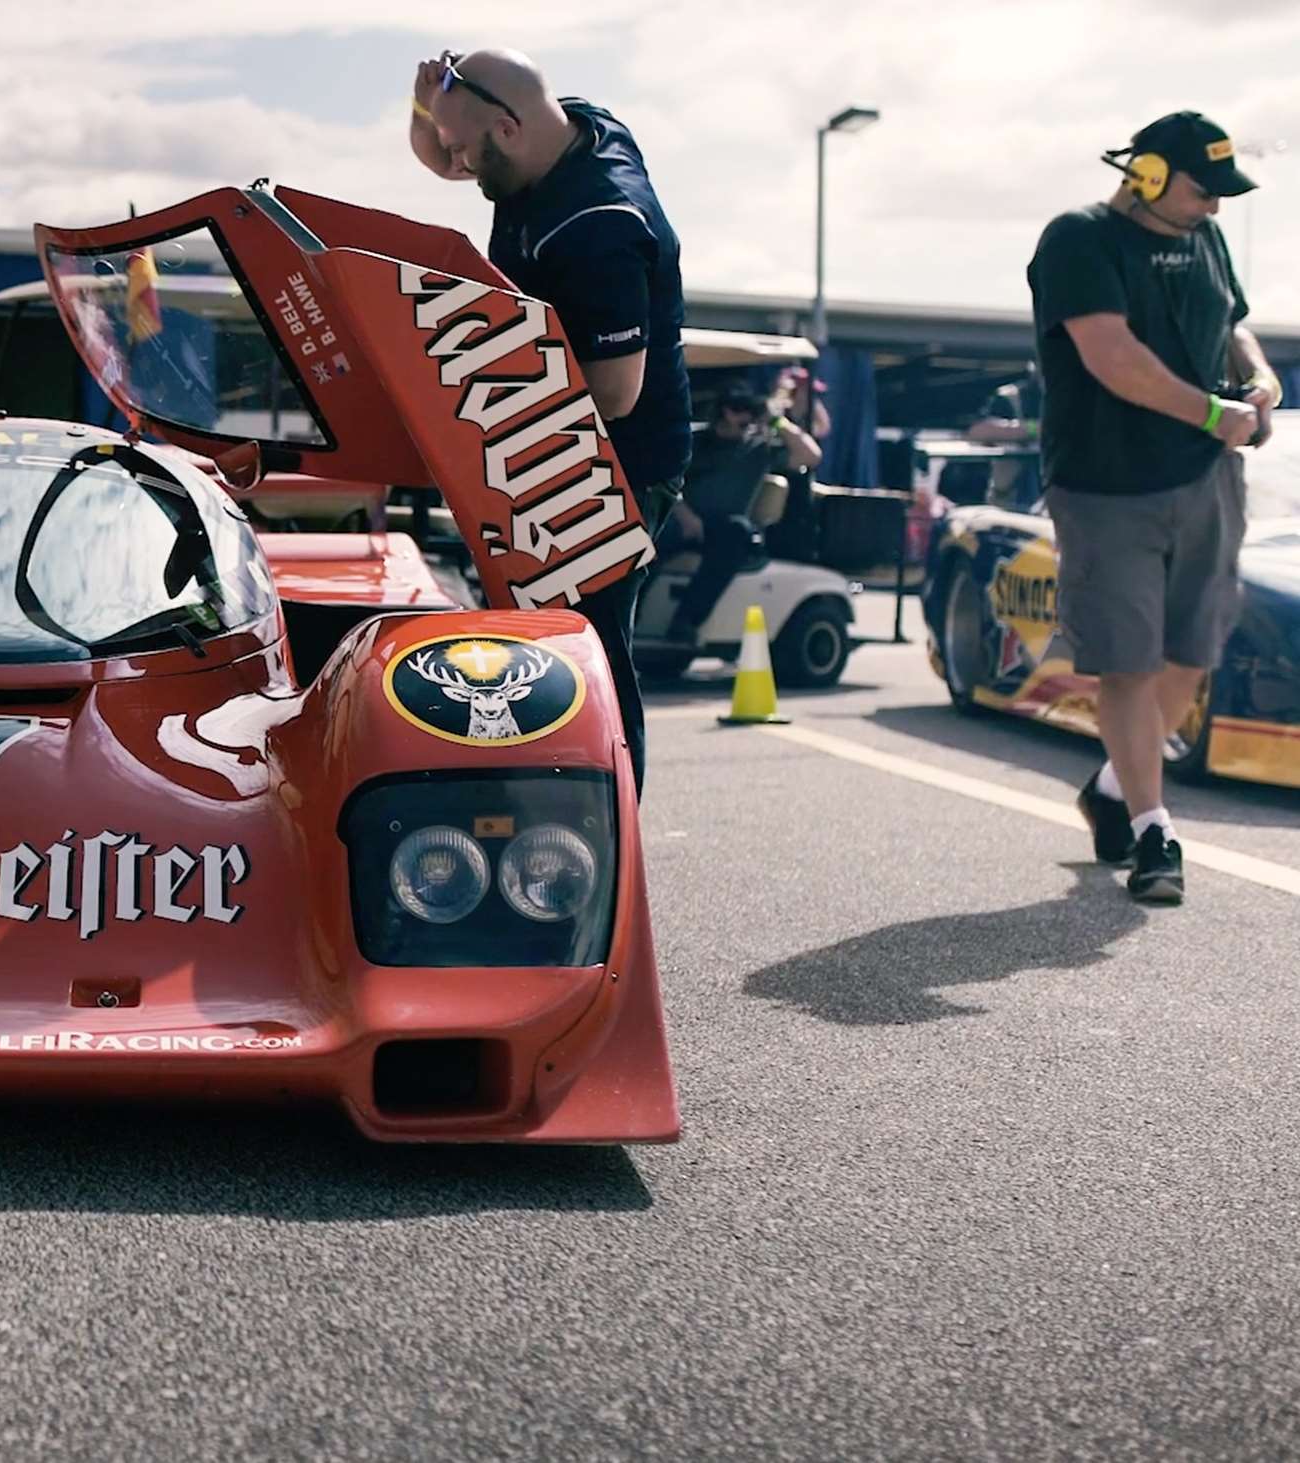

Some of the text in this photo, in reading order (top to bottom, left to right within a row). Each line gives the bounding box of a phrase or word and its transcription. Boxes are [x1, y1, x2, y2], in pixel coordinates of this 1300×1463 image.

[275, 289, 317, 355] D. BELL
[287, 271, 337, 346] B. HAWE
[996, 567, 1060, 624] SUNOC
